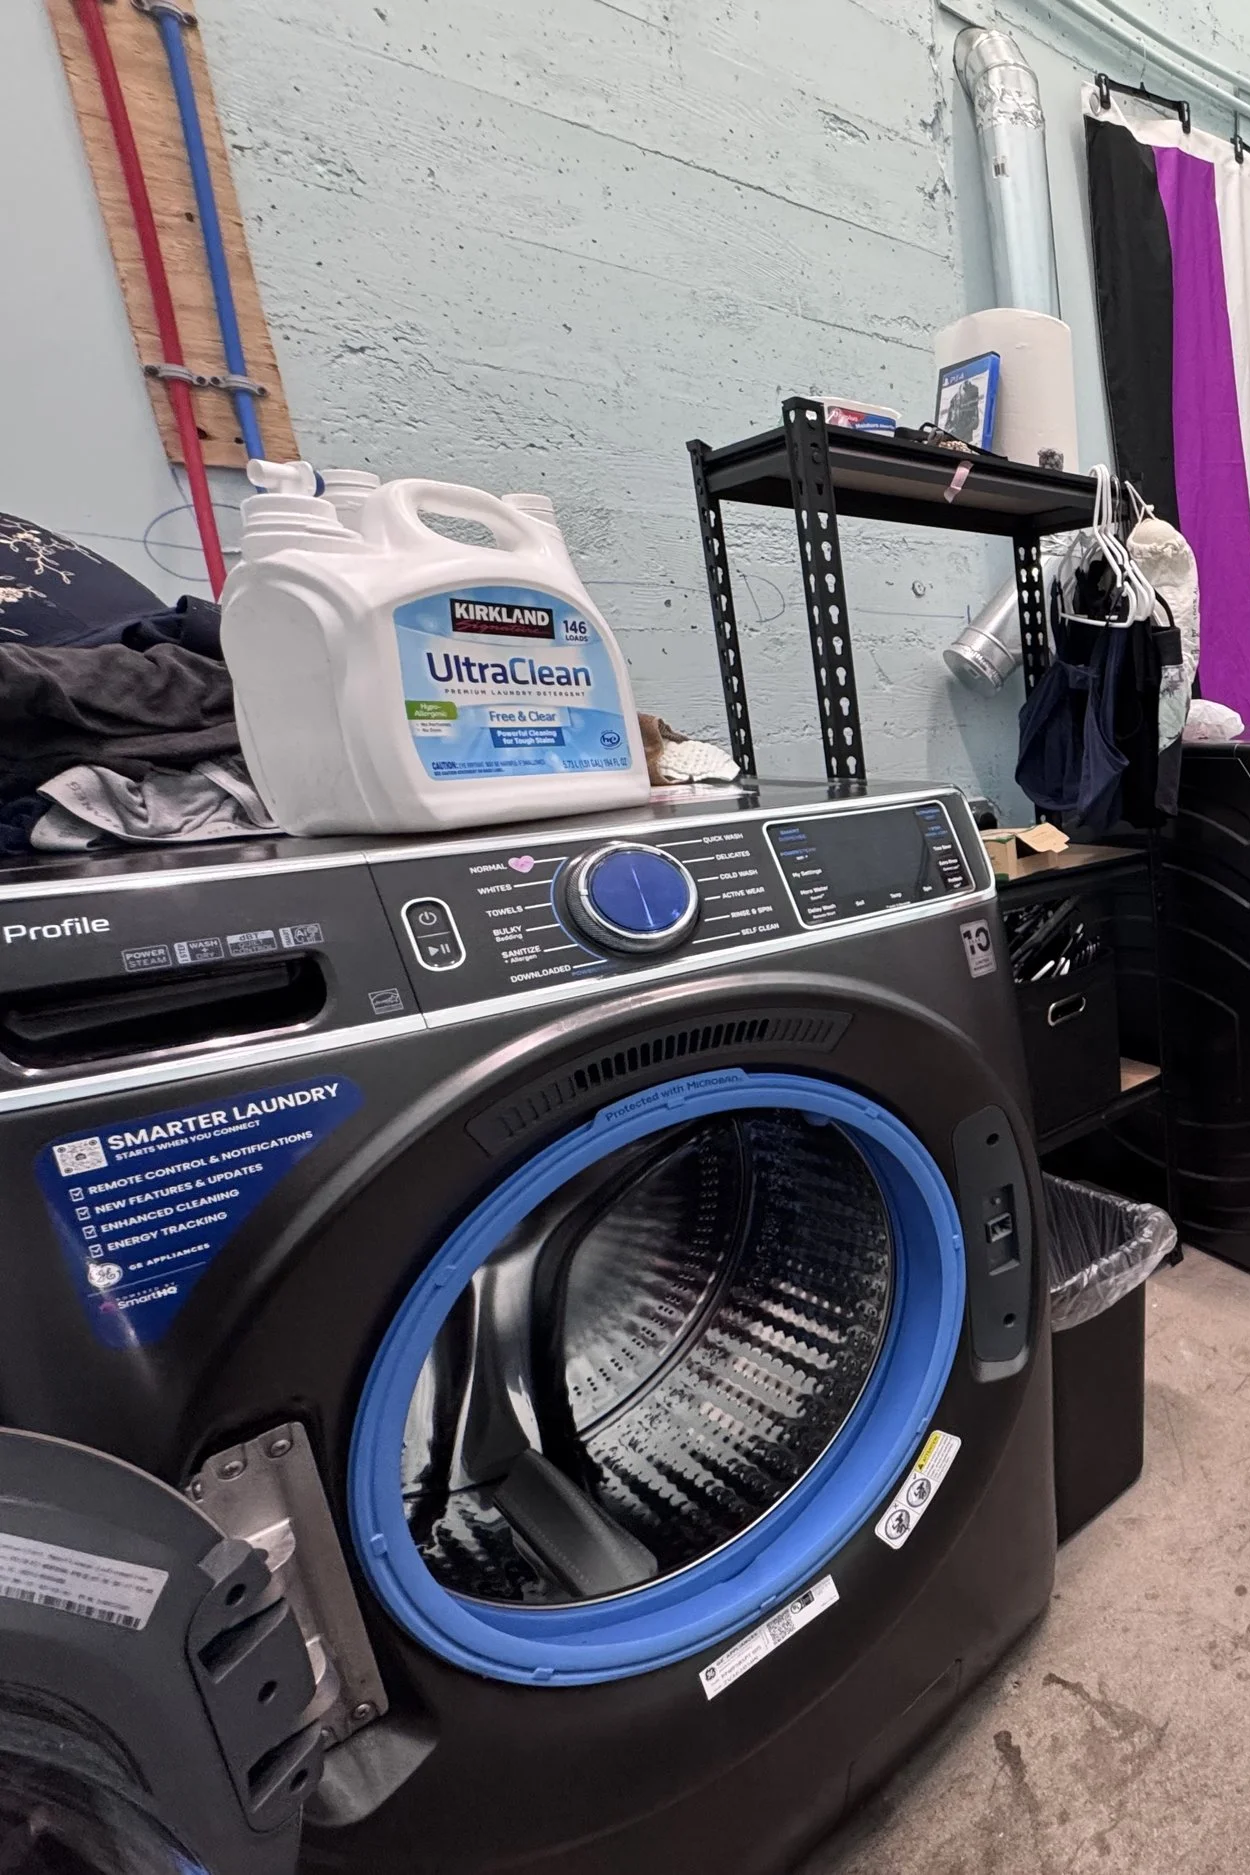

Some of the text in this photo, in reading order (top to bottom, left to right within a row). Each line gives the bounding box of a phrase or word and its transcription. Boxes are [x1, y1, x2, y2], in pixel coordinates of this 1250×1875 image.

[950, 372, 964, 385] PS4
[454, 602, 549, 626] KIRKLAND
[455, 620, 551, 635] Signature
[563, 620, 587, 634] 146
[426, 652, 592, 686] UltraClean
[489, 710, 557, 722] Free & Clear
[497, 729, 557, 738] Powerful Cleaning
[503, 737, 514, 745] for
[514, 737, 535, 746] Tough
[703, 835, 723, 844] QUICK
[715, 850, 750, 860] DELICATES
[469, 863, 507, 874] NORMAL
[719, 869, 758, 880] COLD WASH
[477, 884, 512, 895] WHITES
[722, 887, 765, 899] ACTIVE WEAR
[486, 905, 523, 917] TOWELS
[731, 909, 751, 918] RINSE
[757, 905, 773, 913] SPIN
[3, 916, 111, 944] Profile
[492, 925, 522, 937] BULKY
[741, 923, 779, 935] SELF CLEAN
[495, 933, 523, 943] Bedding
[189, 940, 218, 949] WASH
[125, 948, 165, 960] POWER
[195, 951, 215, 959] DRY
[501, 945, 541, 959] SANITIZE
[129, 957, 167, 969] STEAM
[510, 954, 538, 964] Allergen
[510, 964, 572, 983] DOWNLOADED
[605, 1092, 660, 1122] Protected
[661, 1084, 684, 1100] with
[107, 1083, 340, 1151] SMARTER LAUNDRY
[115, 1119, 261, 1162] STARTS WHEN YOU CONNECT
[88, 1129, 313, 1196] REMOTE CONTROL & NOTIFICATIONS
[94, 1163, 264, 1215] NEW FEATURES & UPDATES
[101, 1188, 240, 1233] ENHANCED CLEANING
[107, 1211, 228, 1252] ENERGY TRACKING
[128, 1242, 210, 1271] GE APPLIANCES
[117, 1285, 178, 1310] SmartHQ
